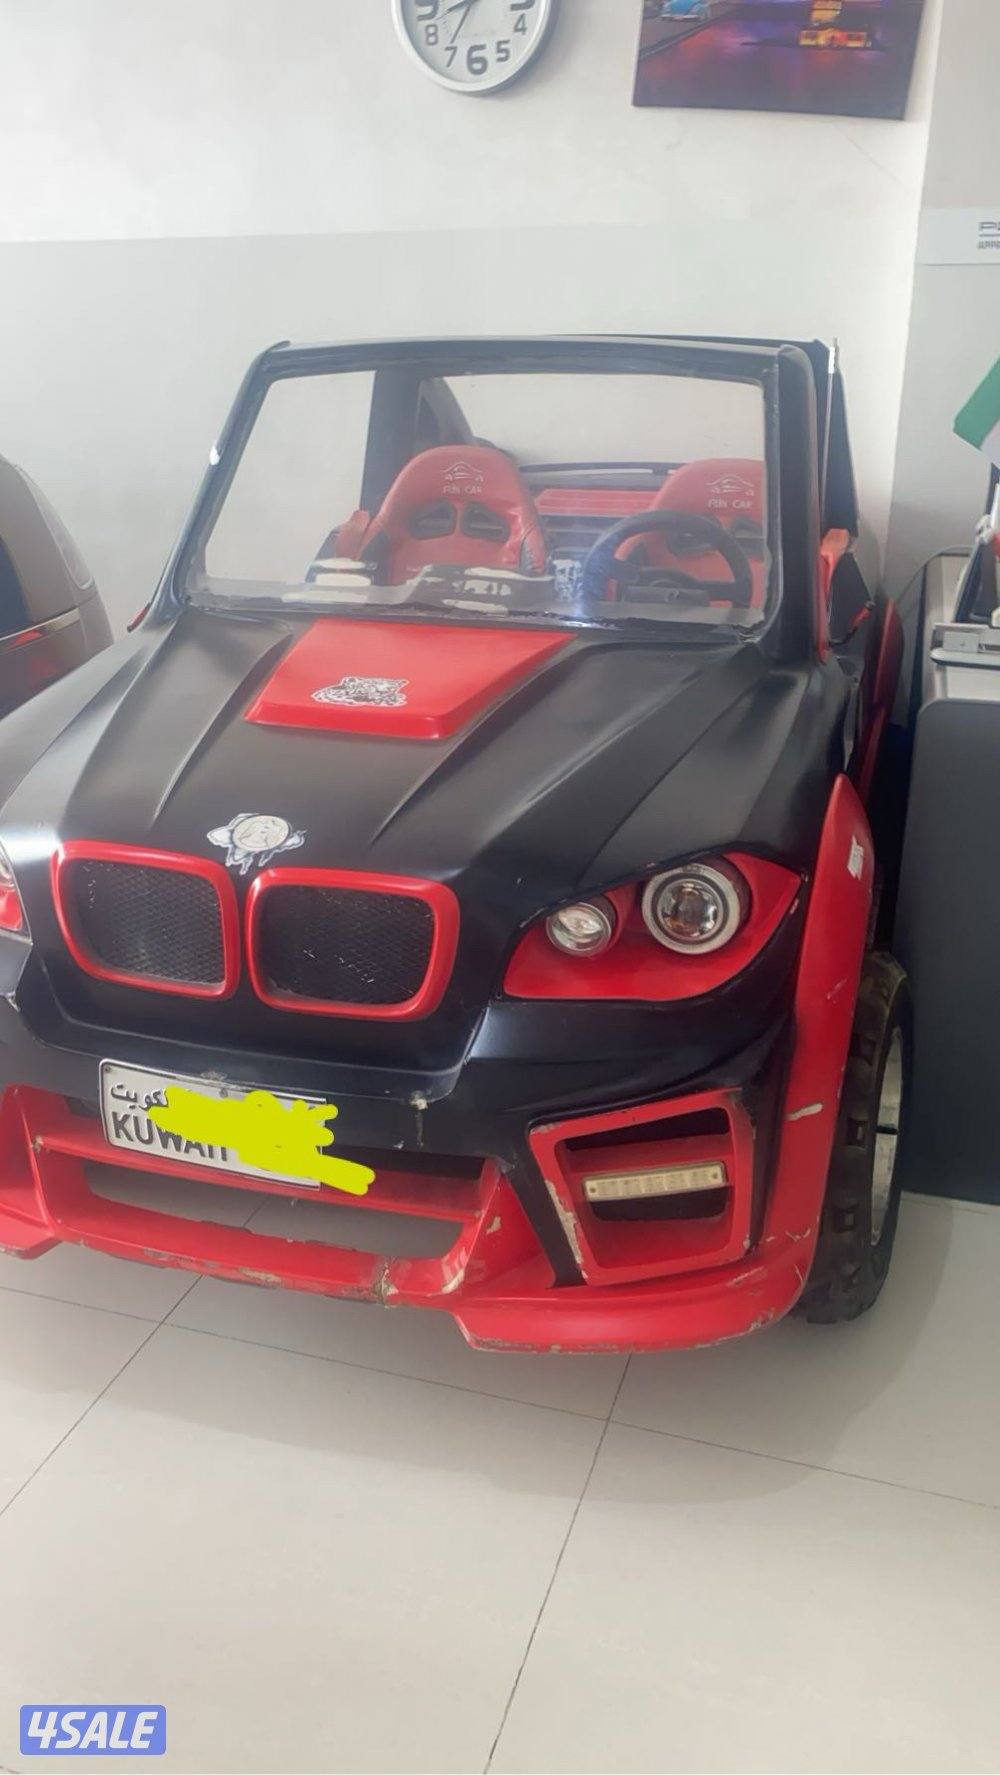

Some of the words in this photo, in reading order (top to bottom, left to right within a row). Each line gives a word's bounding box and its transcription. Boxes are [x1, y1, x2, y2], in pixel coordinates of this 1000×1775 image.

[425, 24, 439, 46] 8
[514, 13, 527, 35] 4
[445, 46, 458, 68] 7
[466, 44, 488, 75] 6
[496, 40, 511, 62] 5
[464, 485, 482, 494] CAR
[732, 499, 753, 509] CAR
